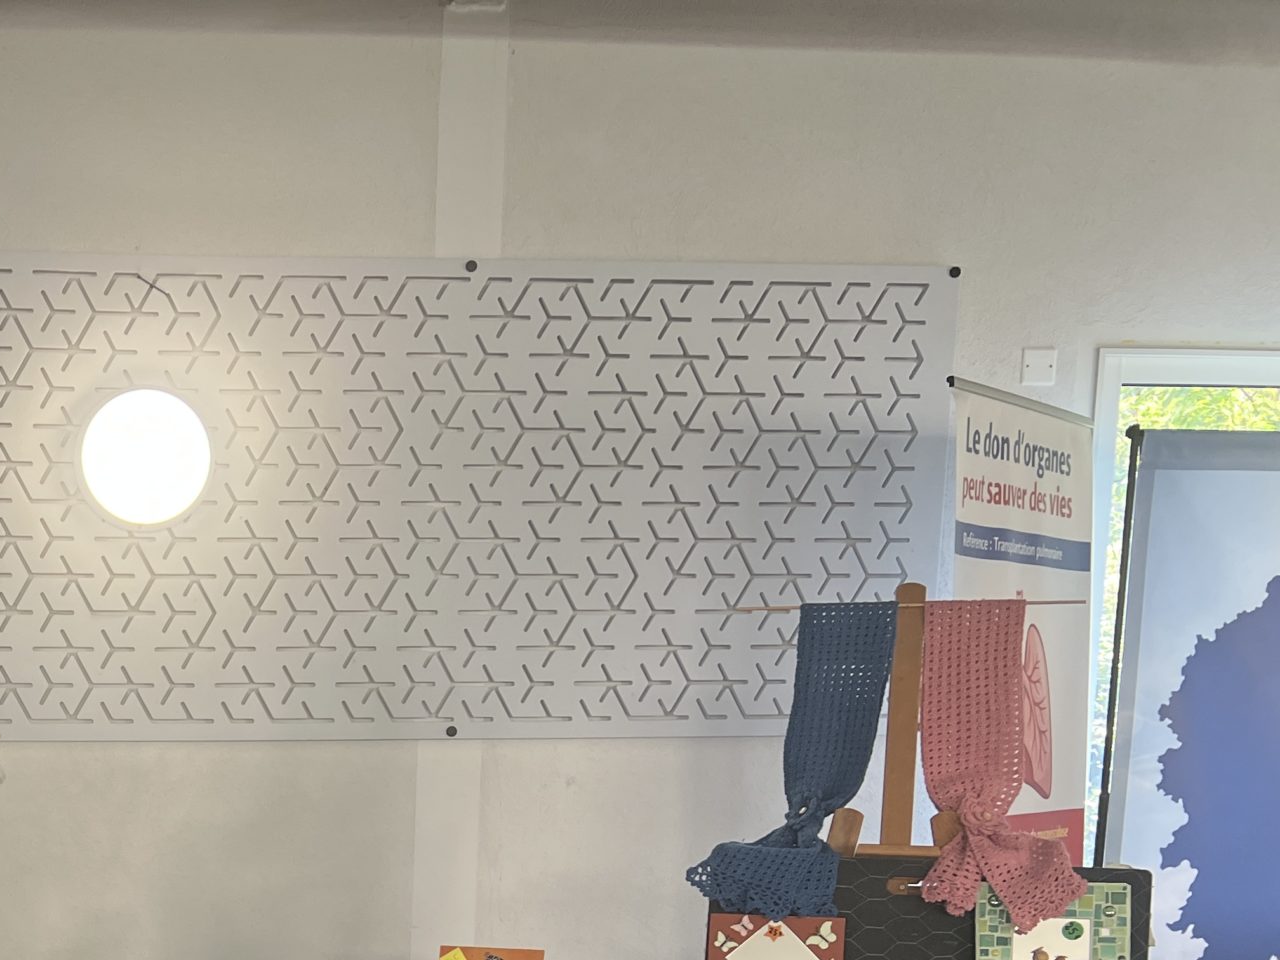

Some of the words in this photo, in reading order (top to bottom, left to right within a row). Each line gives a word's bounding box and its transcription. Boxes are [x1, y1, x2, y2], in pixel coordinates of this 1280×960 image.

[966, 417, 980, 455] Le
[984, 422, 1010, 461] don
[1013, 429, 1072, 479] d'organes
[962, 475, 985, 508] peut
[987, 481, 1027, 510] sauver
[1029, 481, 1047, 513] des
[1050, 485, 1073, 519] vies
